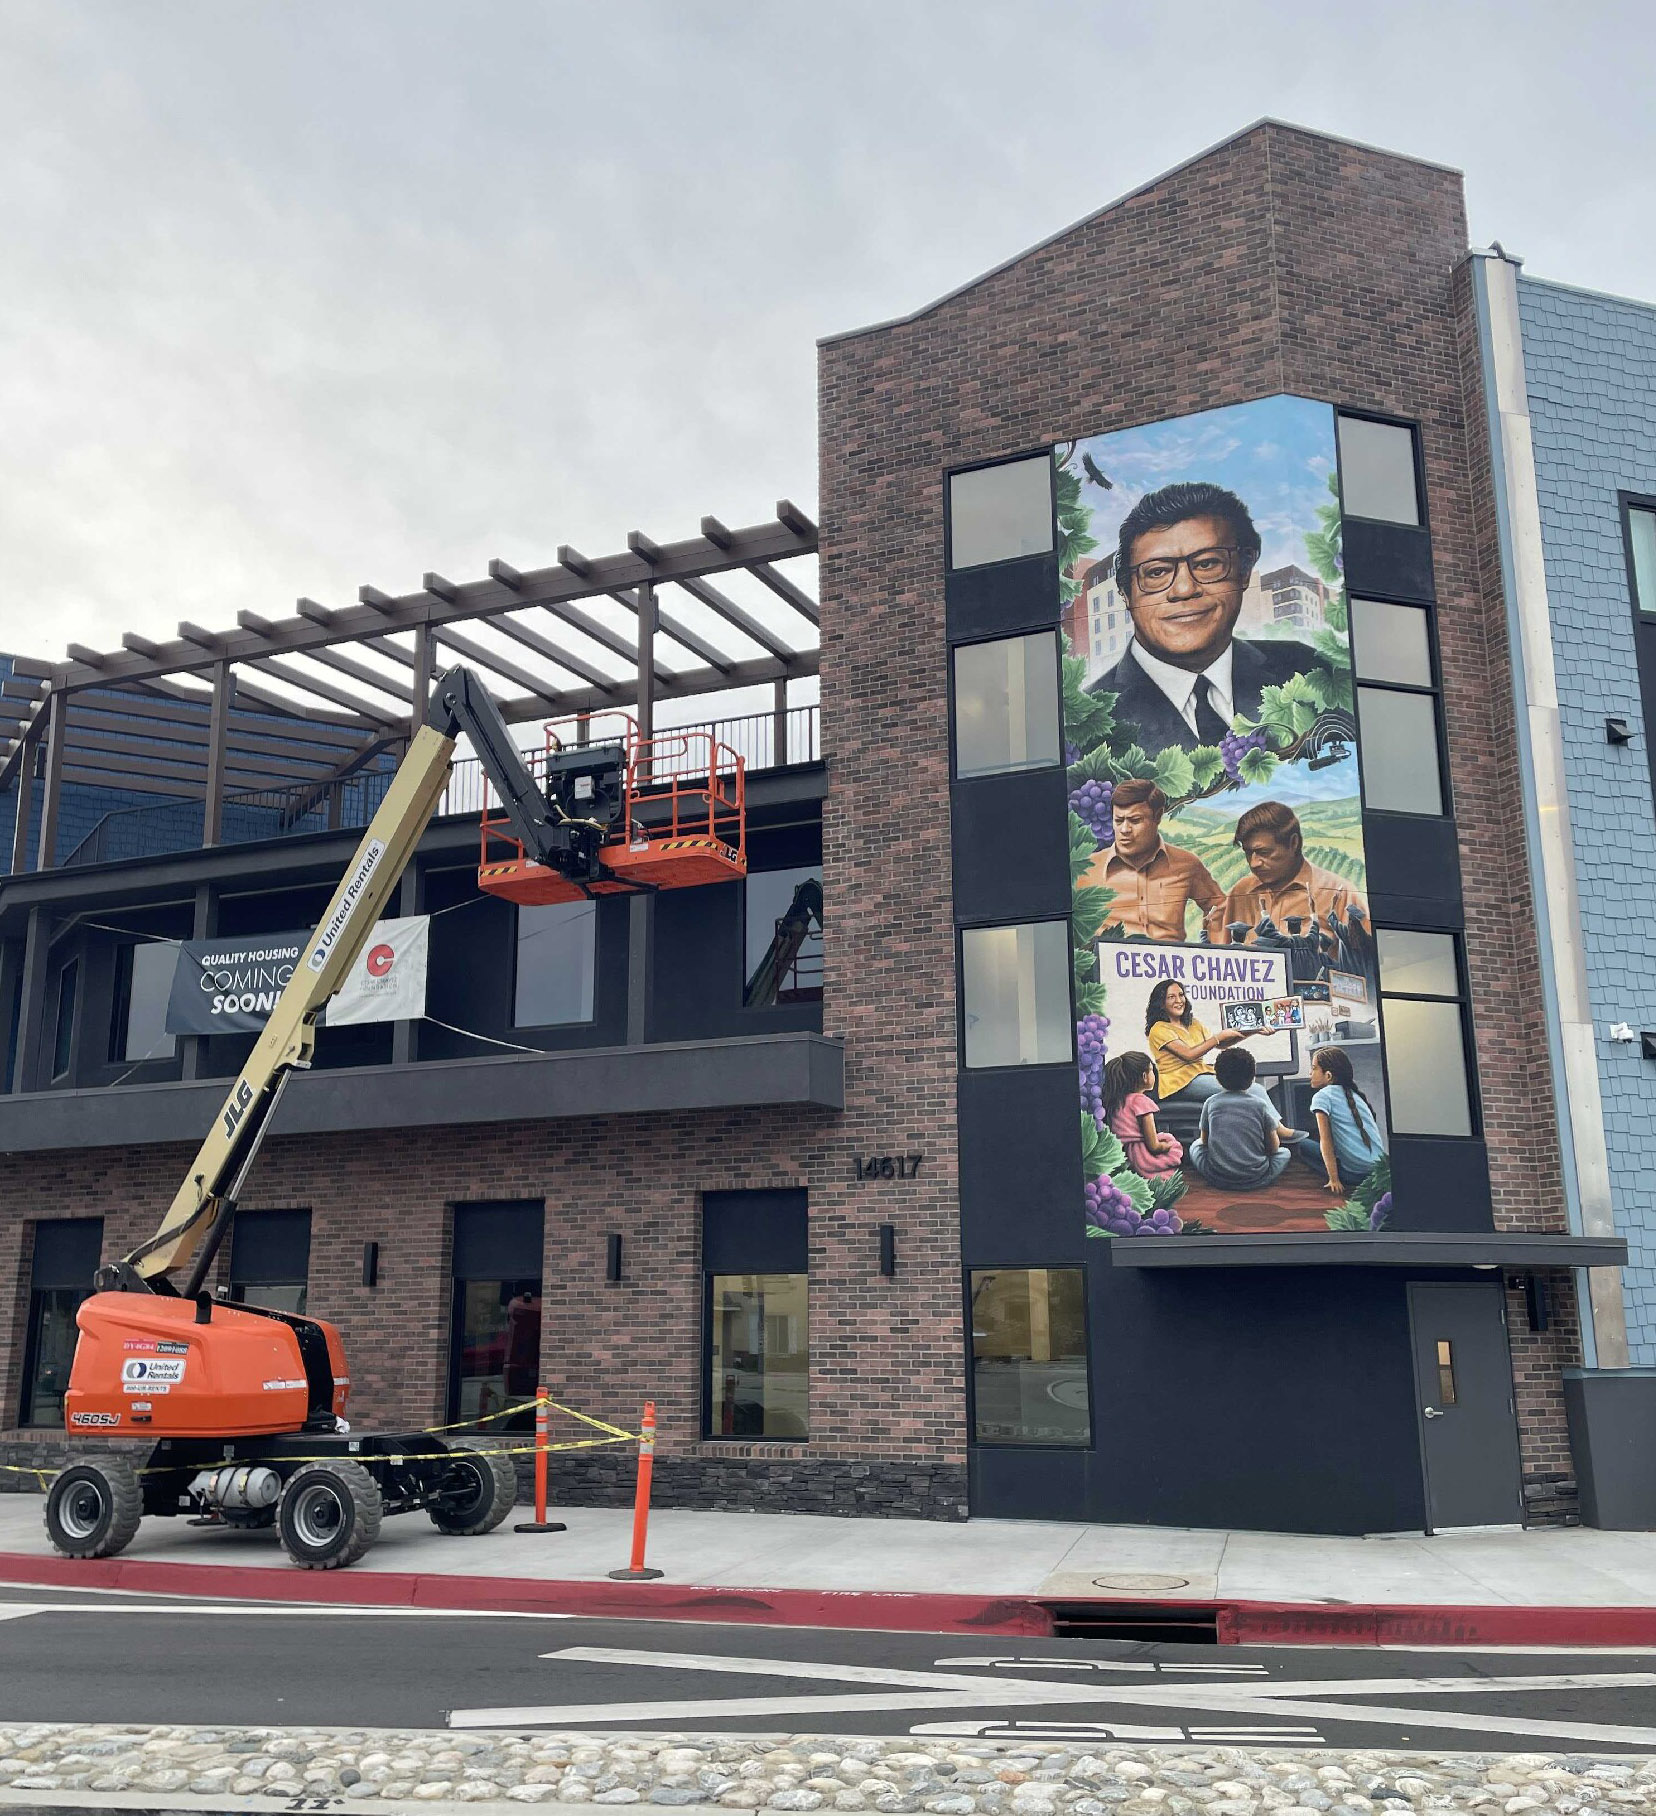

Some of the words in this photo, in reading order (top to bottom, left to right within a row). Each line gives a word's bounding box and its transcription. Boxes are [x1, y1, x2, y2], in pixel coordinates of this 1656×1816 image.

[321, 898, 352, 947] United
[347, 845, 380, 899] Rentals
[201, 951, 248, 966] QUALITY
[248, 946, 299, 962] HOUSING
[1115, 951, 1185, 979] CESAR
[1191, 954, 1275, 983] CHAVEZ
[200, 964, 294, 992] COMING
[1184, 984, 1265, 1001] FOUNDATION
[223, 1078, 254, 1140] JLG
[853, 1155, 923, 1181] 14617
[147, 1371, 180, 1380] Rentals
[149, 1362, 180, 1371] United
[72, 1413, 121, 1425] 460SJ
